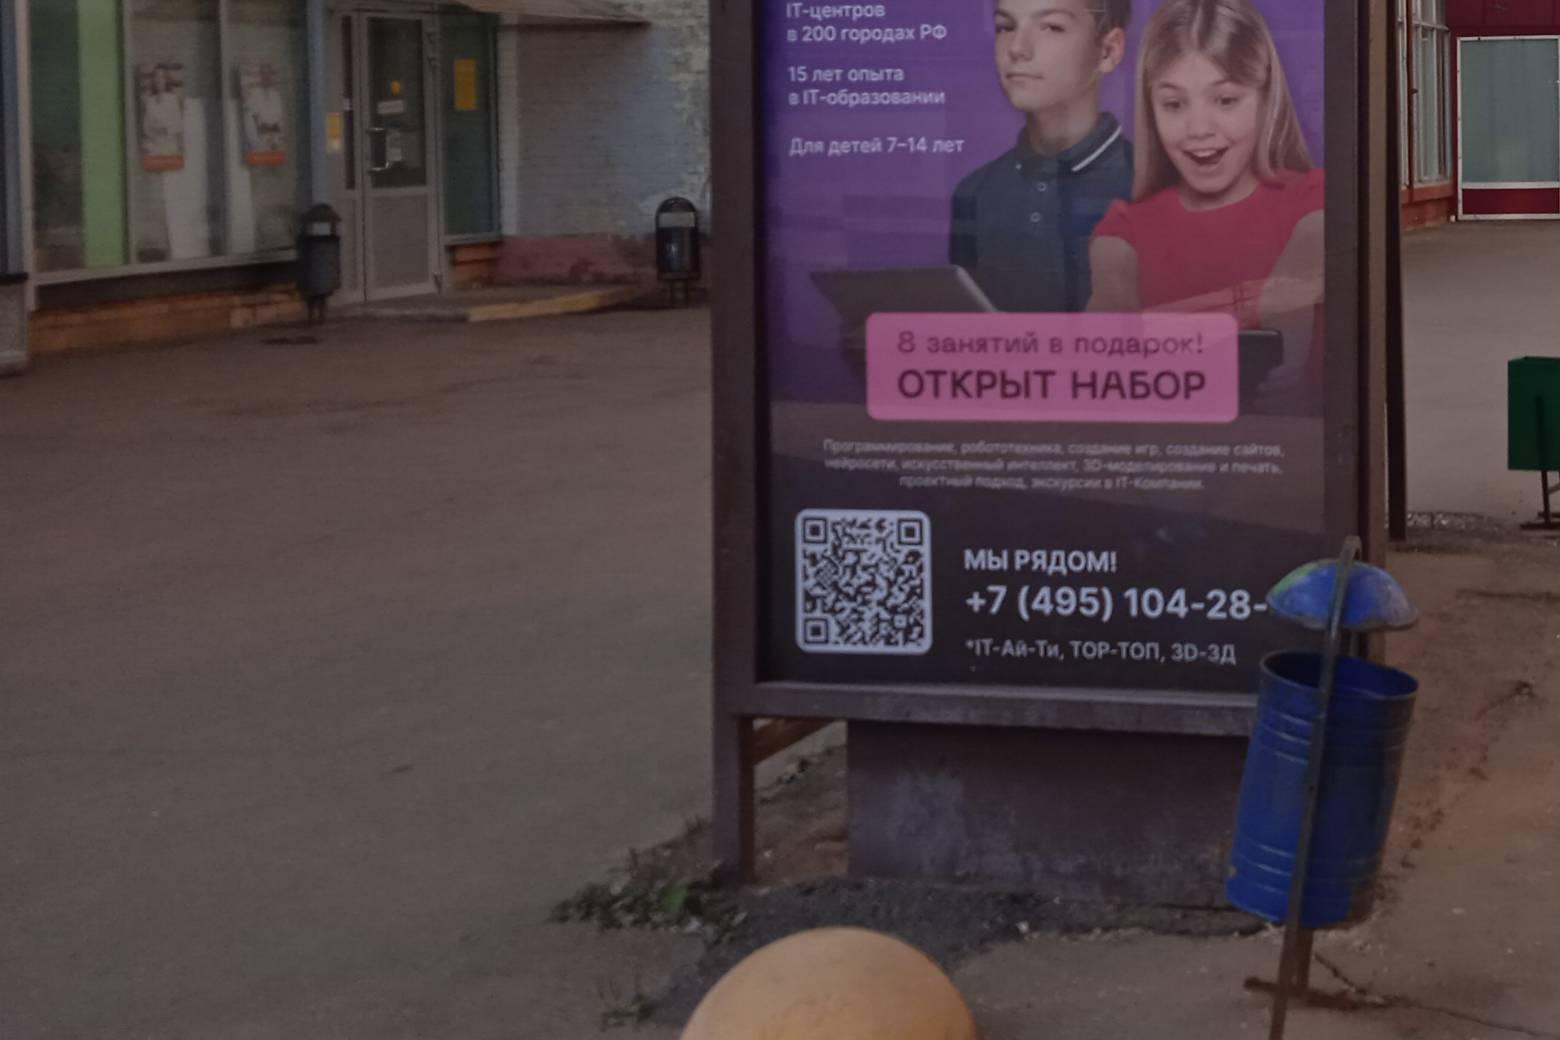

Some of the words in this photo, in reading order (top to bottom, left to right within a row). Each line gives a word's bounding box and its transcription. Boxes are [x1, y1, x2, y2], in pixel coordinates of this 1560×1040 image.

[785, 2, 886, 21] IT-центров
[786, 29, 798, 42] в
[802, 25, 836, 42] 200
[840, 27, 915, 44] городах
[919, 24, 948, 40] РФ
[787, 66, 808, 82] 15
[811, 68, 843, 82] лет
[847, 67, 905, 82] опыта
[788, 92, 799, 106] в
[802, 88, 946, 108] IT-образовании
[788, 137, 824, 157] Для
[827, 137, 882, 157] детей
[932, 139, 965, 153] лет
[897, 330, 916, 354] 8
[926, 330, 1039, 354] занятий
[1050, 337, 1064, 354] в
[1073, 331, 1204, 358] подарок!
[897, 368, 1057, 400] ОТКРЫТ
[1071, 369, 1207, 401] НАБОР
[964, 549, 1008, 571] МЫ
[1014, 549, 1117, 576] РЯДОМ!
[965, 585, 1008, 615] +7
[1017, 584, 1113, 622] (495)
